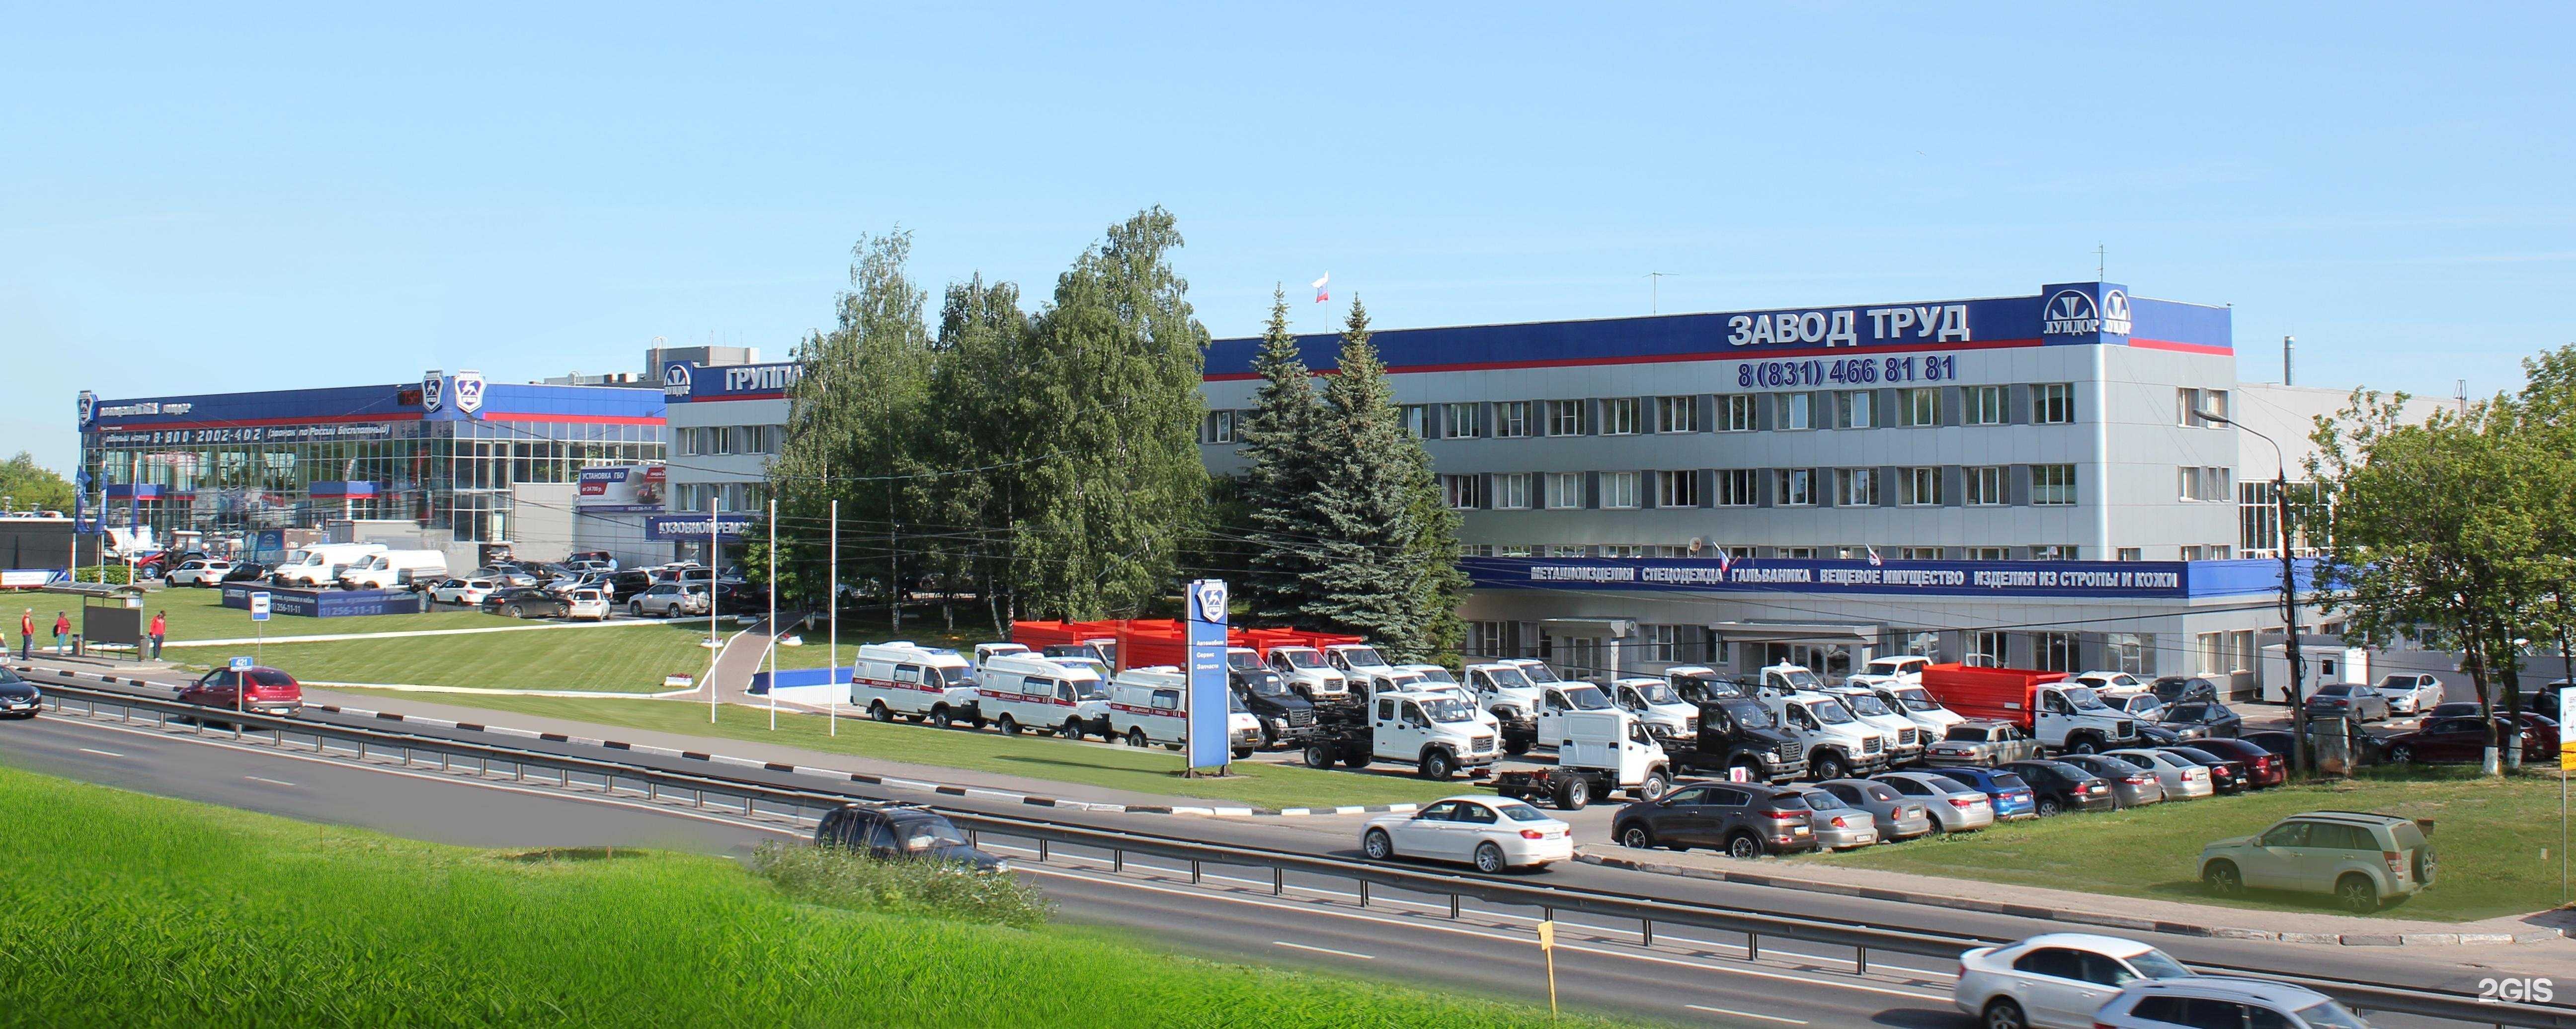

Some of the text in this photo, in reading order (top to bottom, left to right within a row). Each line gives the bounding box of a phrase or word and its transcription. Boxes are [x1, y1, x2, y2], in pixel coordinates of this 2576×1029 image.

[1727, 305, 1970, 347] ЗАВОД ТРУД
[2043, 319, 2099, 336] ЛУИДОР
[1829, 357, 1877, 384] 466
[1885, 356, 1913, 382] 81
[1925, 354, 1954, 380] 81
[1531, 566, 2178, 588] МЕТАЛЛОИЗДЕЛИЯ СПЕЦОДЕЖДА ГАЛЬВАНИКА ВЕЩЕВОЕ ИМУЩЕСТВО ИЗДЕЛИЯ ИЗ СТРОПЫ И КОЖИ
